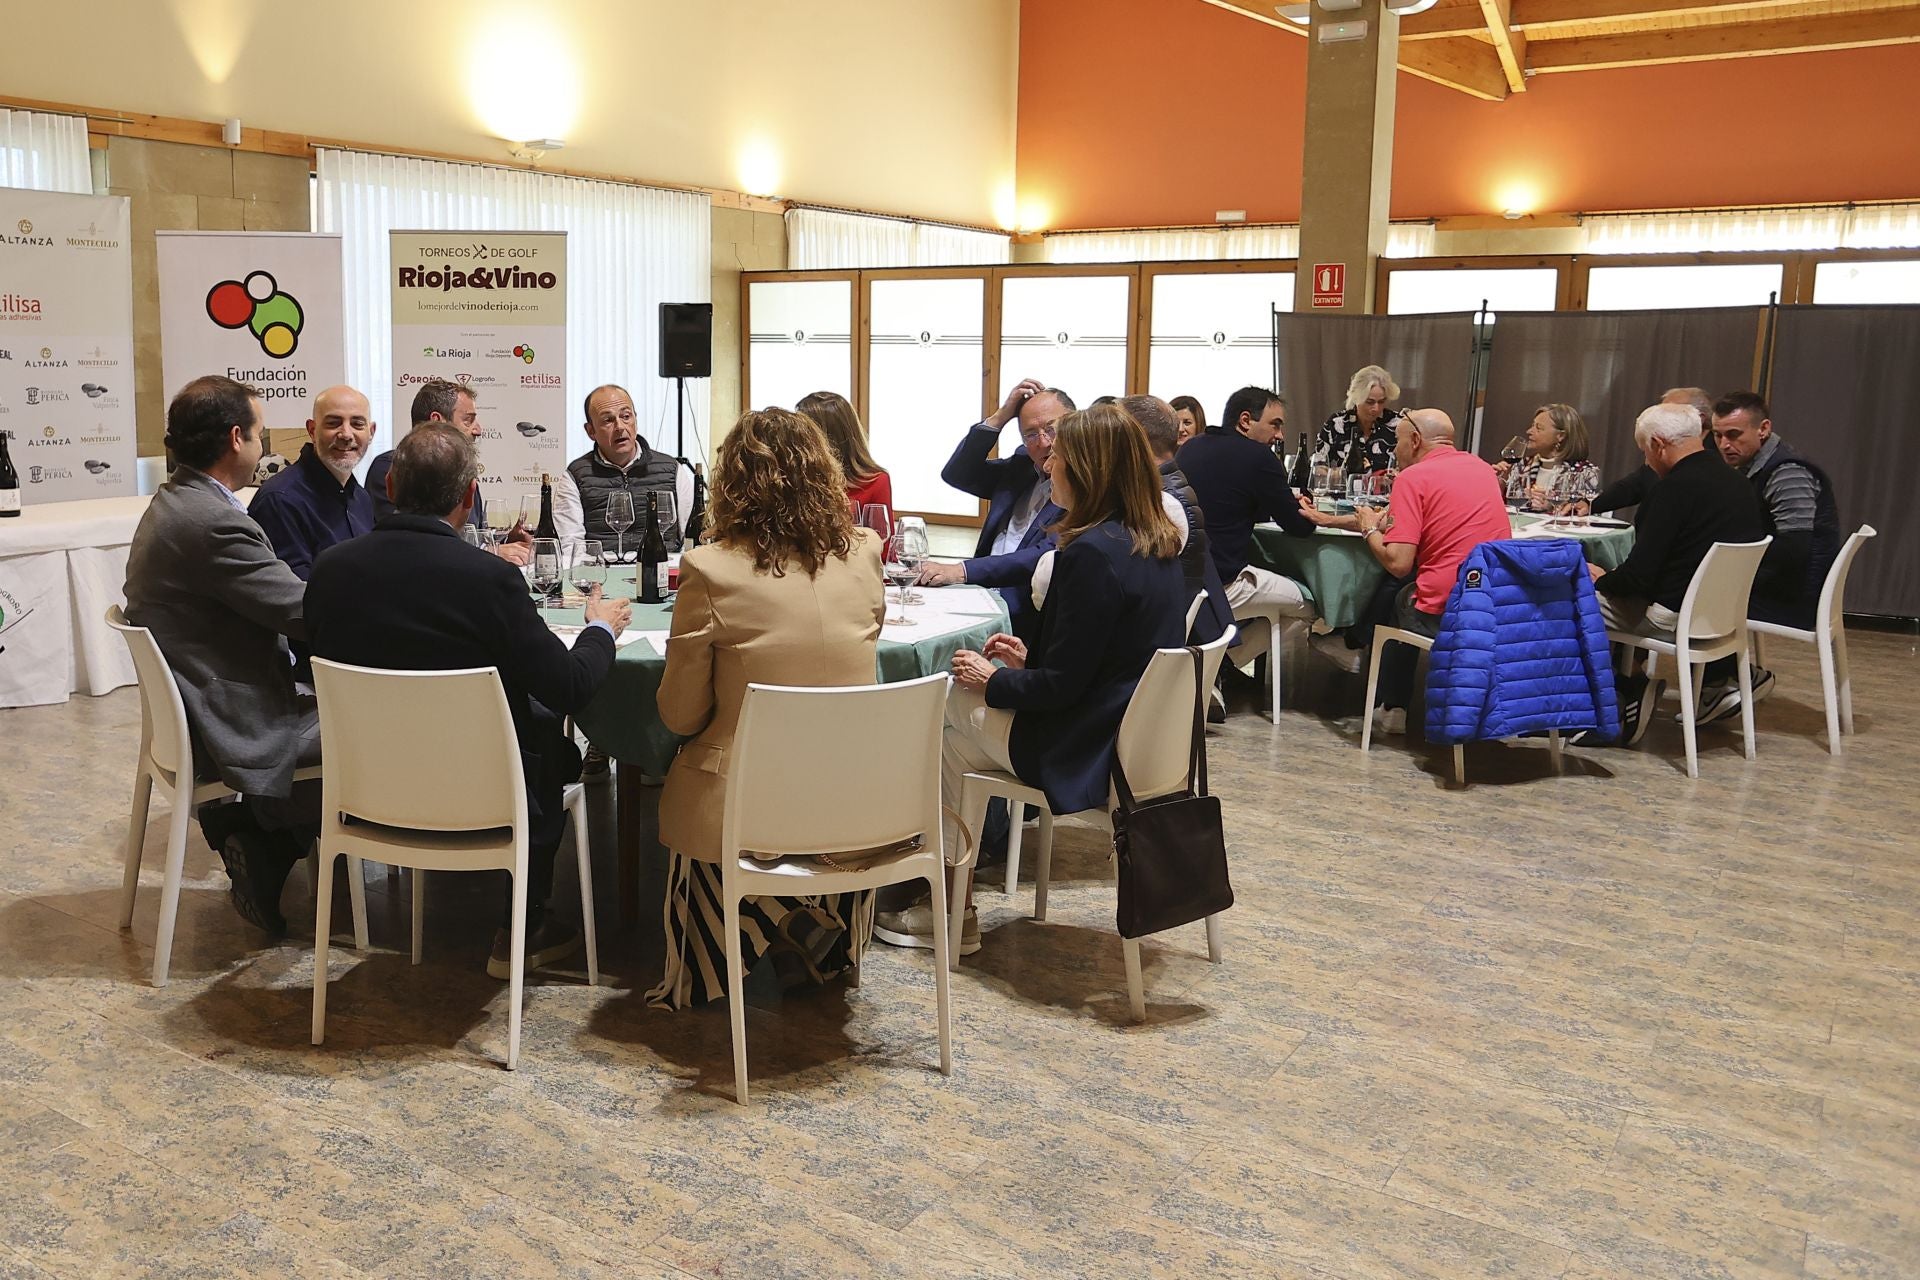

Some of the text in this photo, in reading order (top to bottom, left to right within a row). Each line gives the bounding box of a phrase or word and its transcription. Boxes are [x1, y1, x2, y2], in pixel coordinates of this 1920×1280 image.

[66, 237, 119, 249] MONTECILLO
[419, 247, 538, 258] TORNEOS DE GOLF
[399, 265, 557, 292] Rioja&Vino
[0, 294, 41, 313] ilisa
[1314, 296, 1342, 304] EXTINTOR
[418, 300, 539, 313] lomejordelvinoderioja.com
[436, 348, 471, 359] La Rioja
[25, 360, 68, 368] ALTANZA
[227, 364, 307, 381] Fundación
[258, 385, 307, 401] eporte
[481, 432, 502, 440] RICA
[28, 438, 71, 447] ALTANZA
[513, 475, 560, 483] MONTECLO
